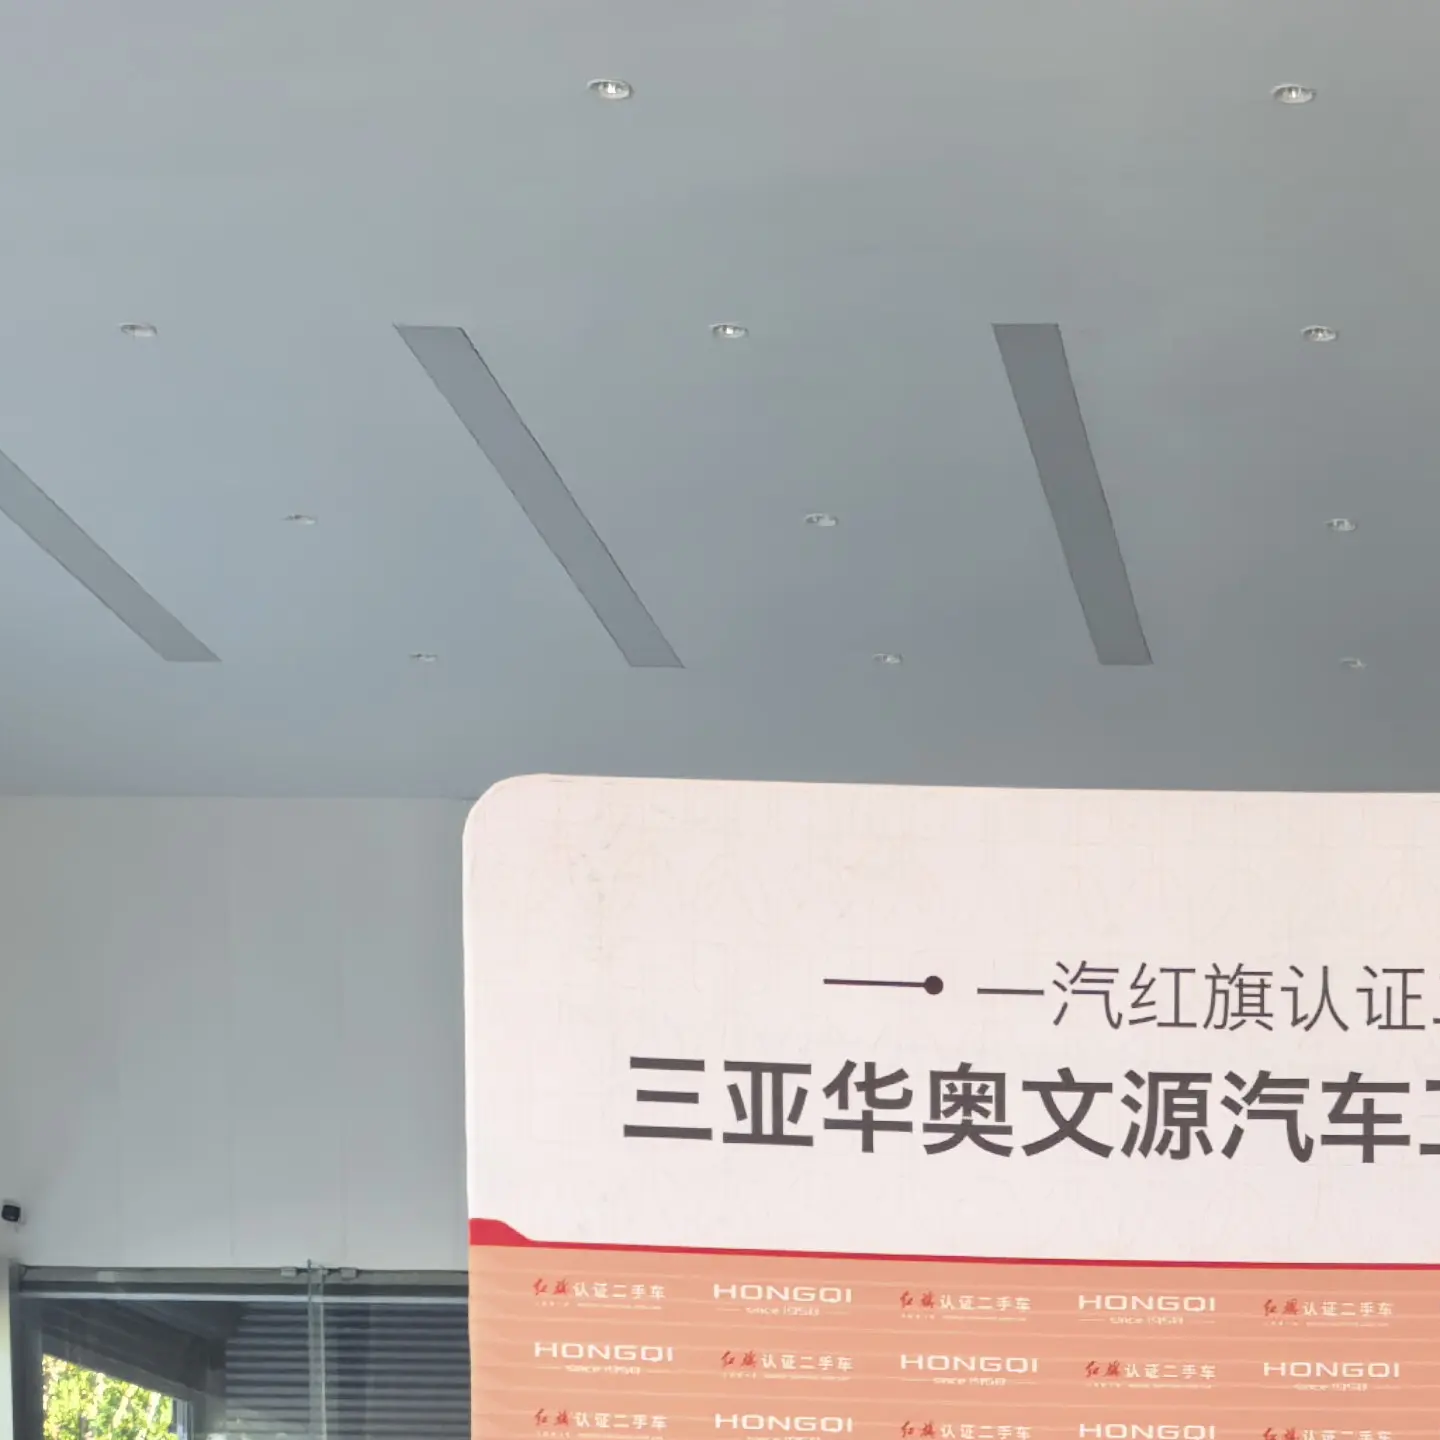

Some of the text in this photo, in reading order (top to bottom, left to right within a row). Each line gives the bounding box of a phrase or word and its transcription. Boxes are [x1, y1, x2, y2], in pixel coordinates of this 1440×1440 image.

[713, 1283, 852, 1304] HONGQI
[1078, 1294, 1216, 1313] HONGQI
[534, 1341, 674, 1363] HONGQI
[900, 1353, 1038, 1374] HONGQI
[1263, 1361, 1400, 1378] HONGQI
[714, 1413, 853, 1434] HONGQI
[1078, 1423, 1216, 1440] HONGQI
